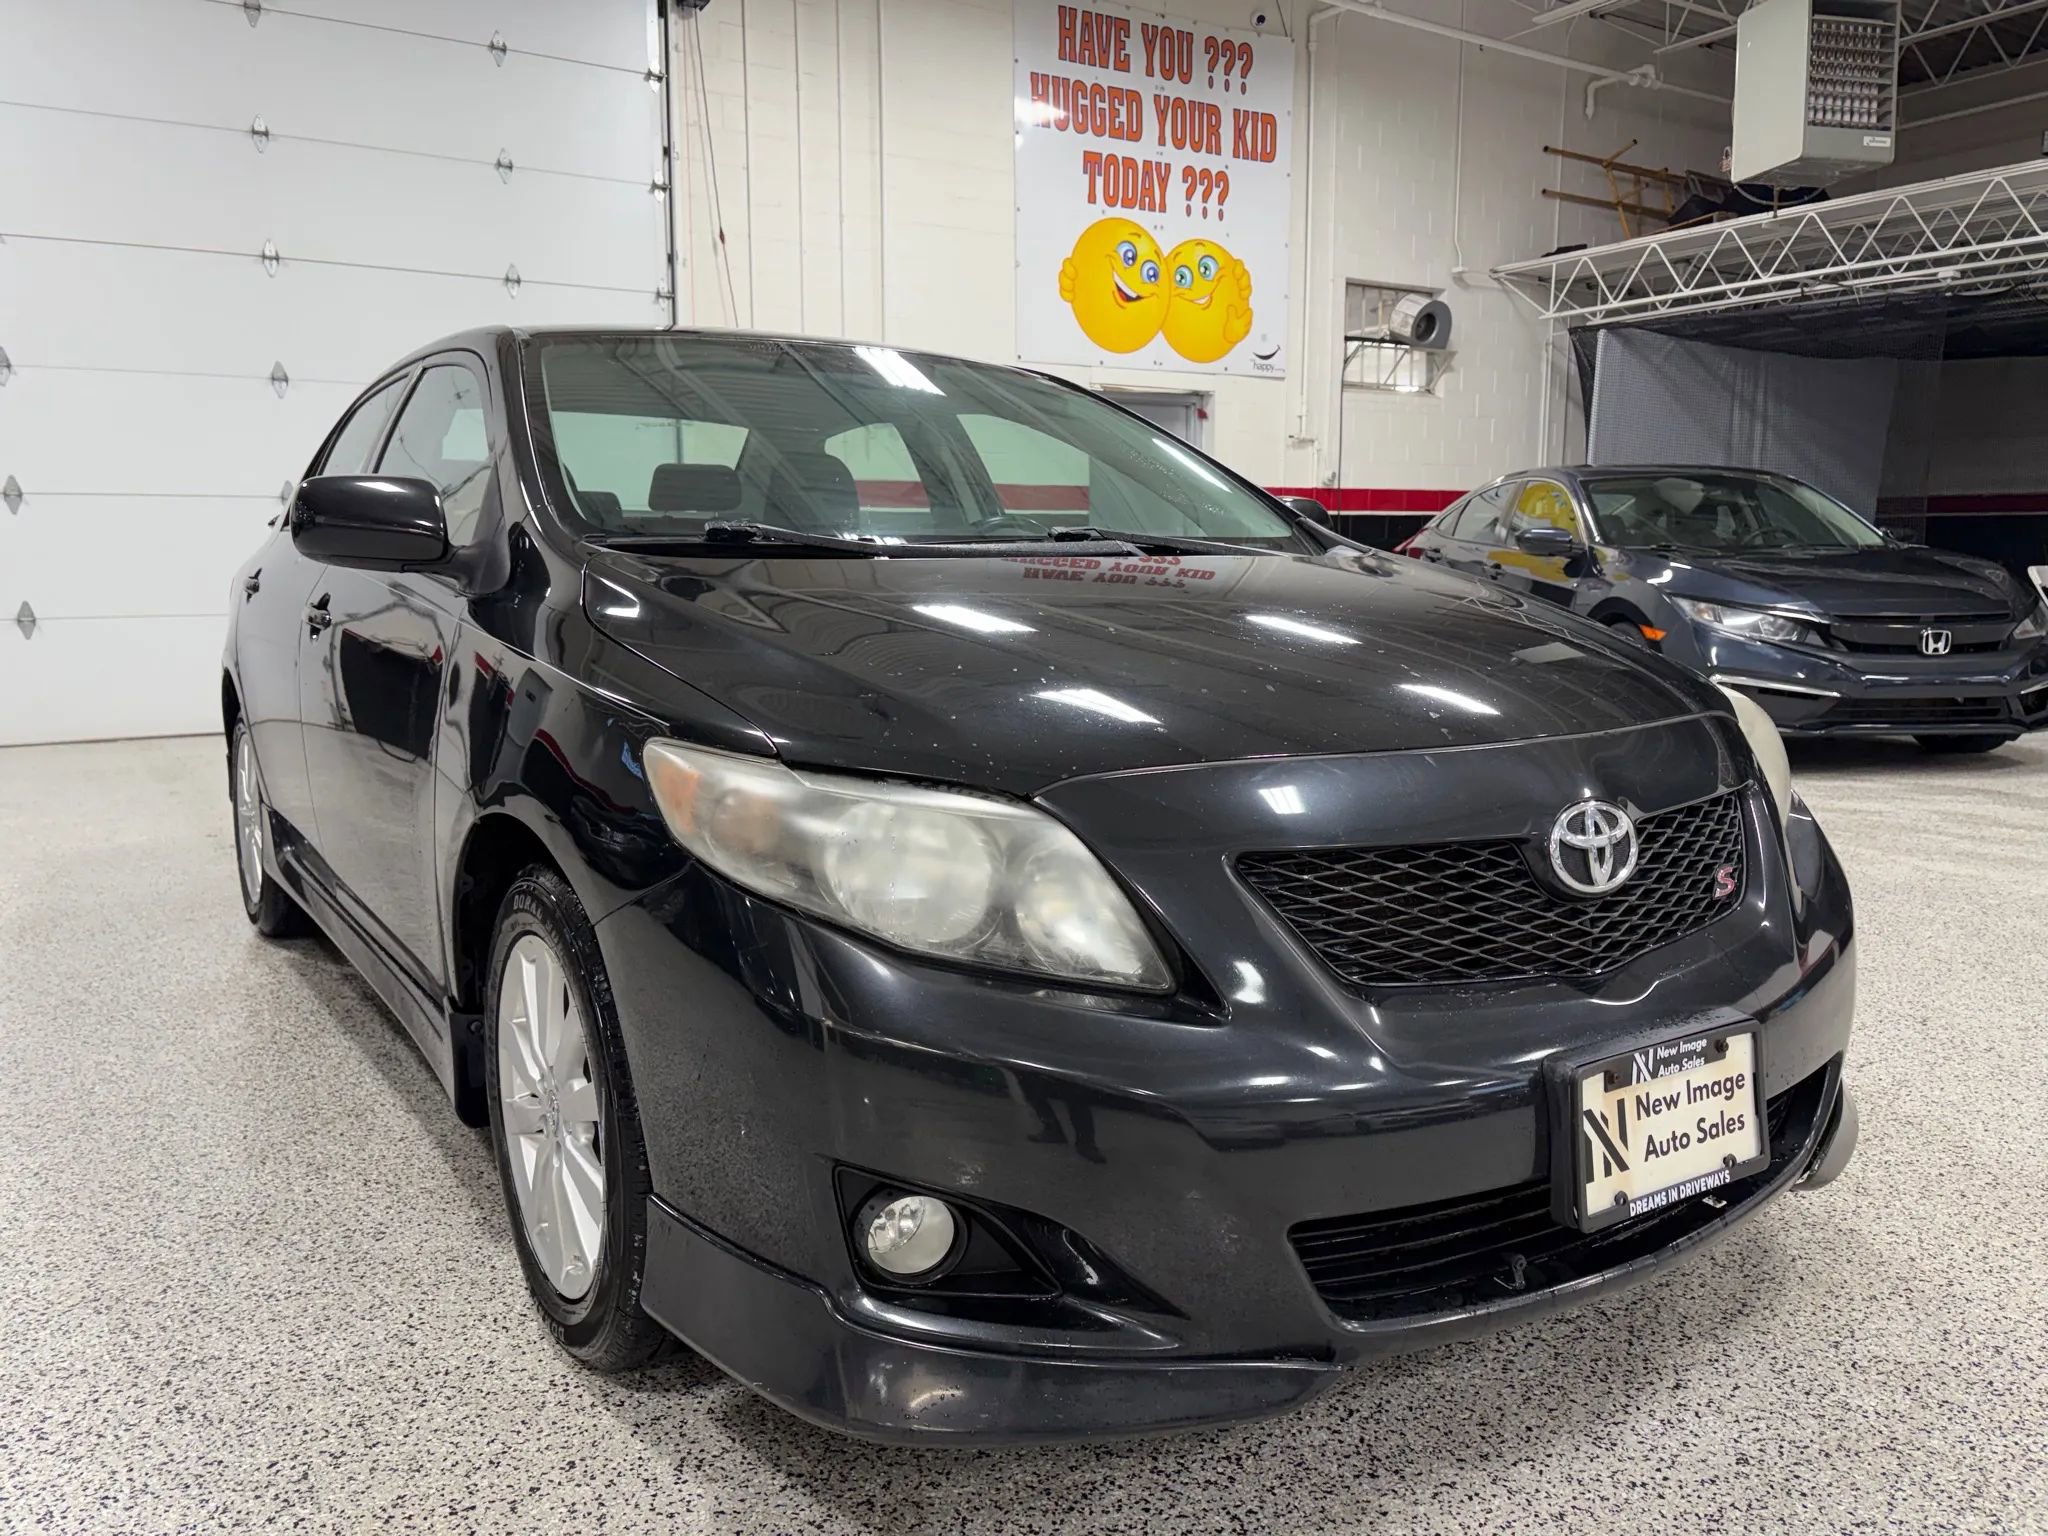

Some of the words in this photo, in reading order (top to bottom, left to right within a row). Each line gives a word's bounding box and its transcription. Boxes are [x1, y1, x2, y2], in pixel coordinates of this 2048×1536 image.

[1058, 4, 1131, 73] HAVE
[1141, 22, 1194, 85] YOU
[1204, 36, 1254, 95] ???
[1030, 72, 1143, 143] HUGGED
[1153, 94, 1222, 156] YOUR
[1232, 108, 1277, 163] KID
[1083, 150, 1171, 214] TODAY
[1182, 165, 1230, 222] ???
[1714, 866, 1735, 898] S
[1656, 1046, 1679, 1061] New
[1680, 1038, 1708, 1053] Image
[1657, 1063, 1680, 1078] Auto
[1681, 1055, 1705, 1071] Sales
[1635, 1091, 1681, 1121] New
[1686, 1072, 1746, 1105] Image
[1644, 1130, 1691, 1163] Auto
[1696, 1110, 1746, 1144] Sales
[1629, 1191, 1667, 1217] DREAMS
[1668, 1186, 1679, 1203] IN
[1679, 1169, 1731, 1199] DRIVEWAYS
